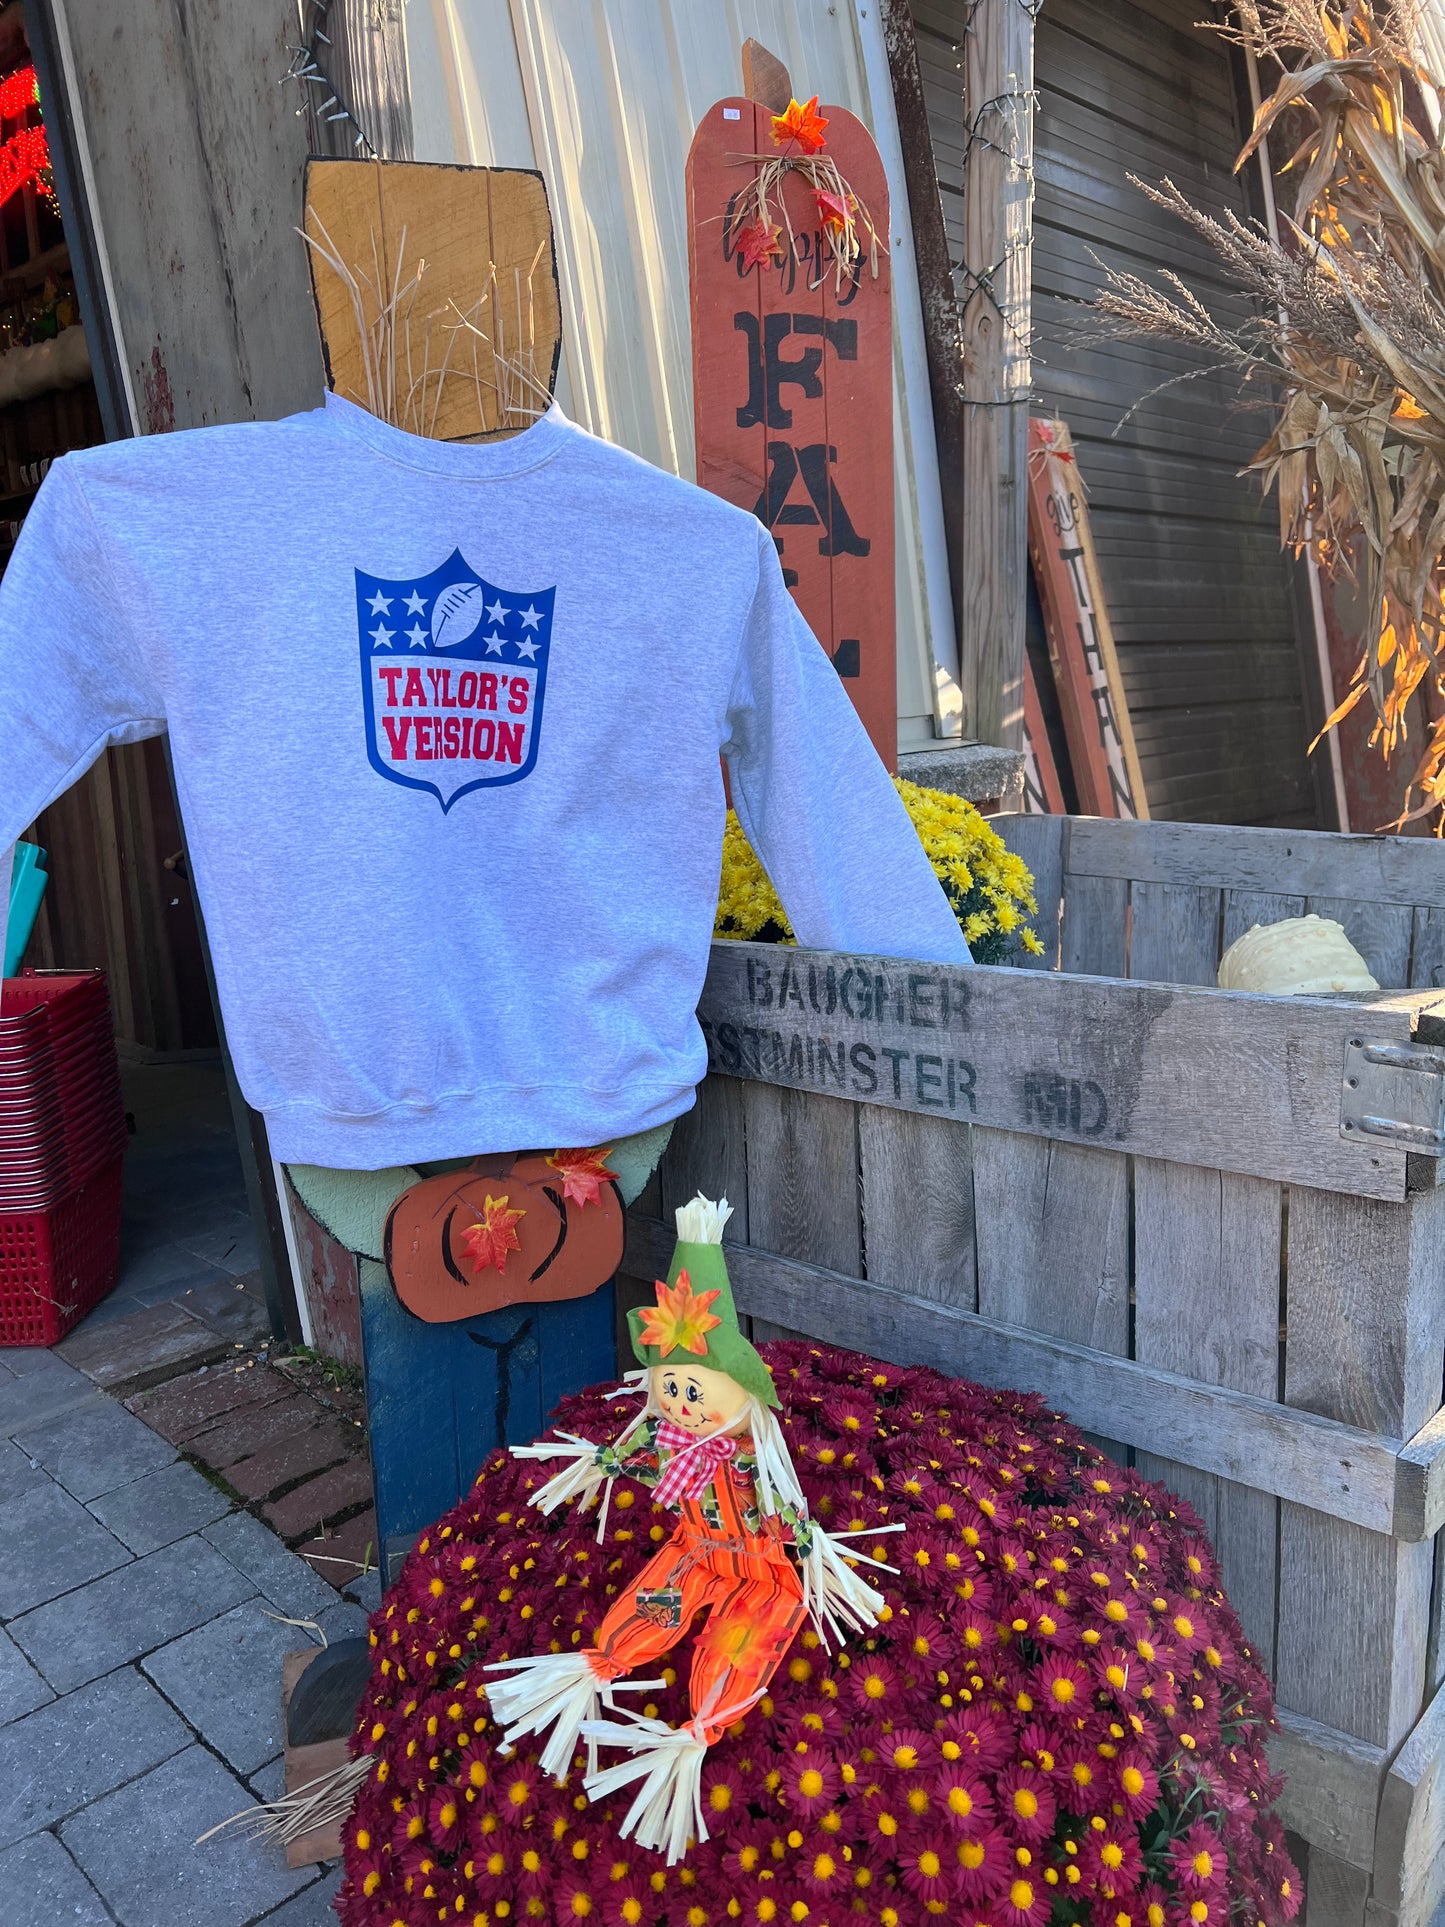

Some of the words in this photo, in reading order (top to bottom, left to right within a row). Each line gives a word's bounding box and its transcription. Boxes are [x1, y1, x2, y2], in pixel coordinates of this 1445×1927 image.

[734, 311, 871, 678] FA
[1046, 491, 1080, 537] give
[379, 668, 530, 715] TAYLOR'S
[382, 716, 526, 765] VERSION
[747, 958, 971, 1031] BAUGHER
